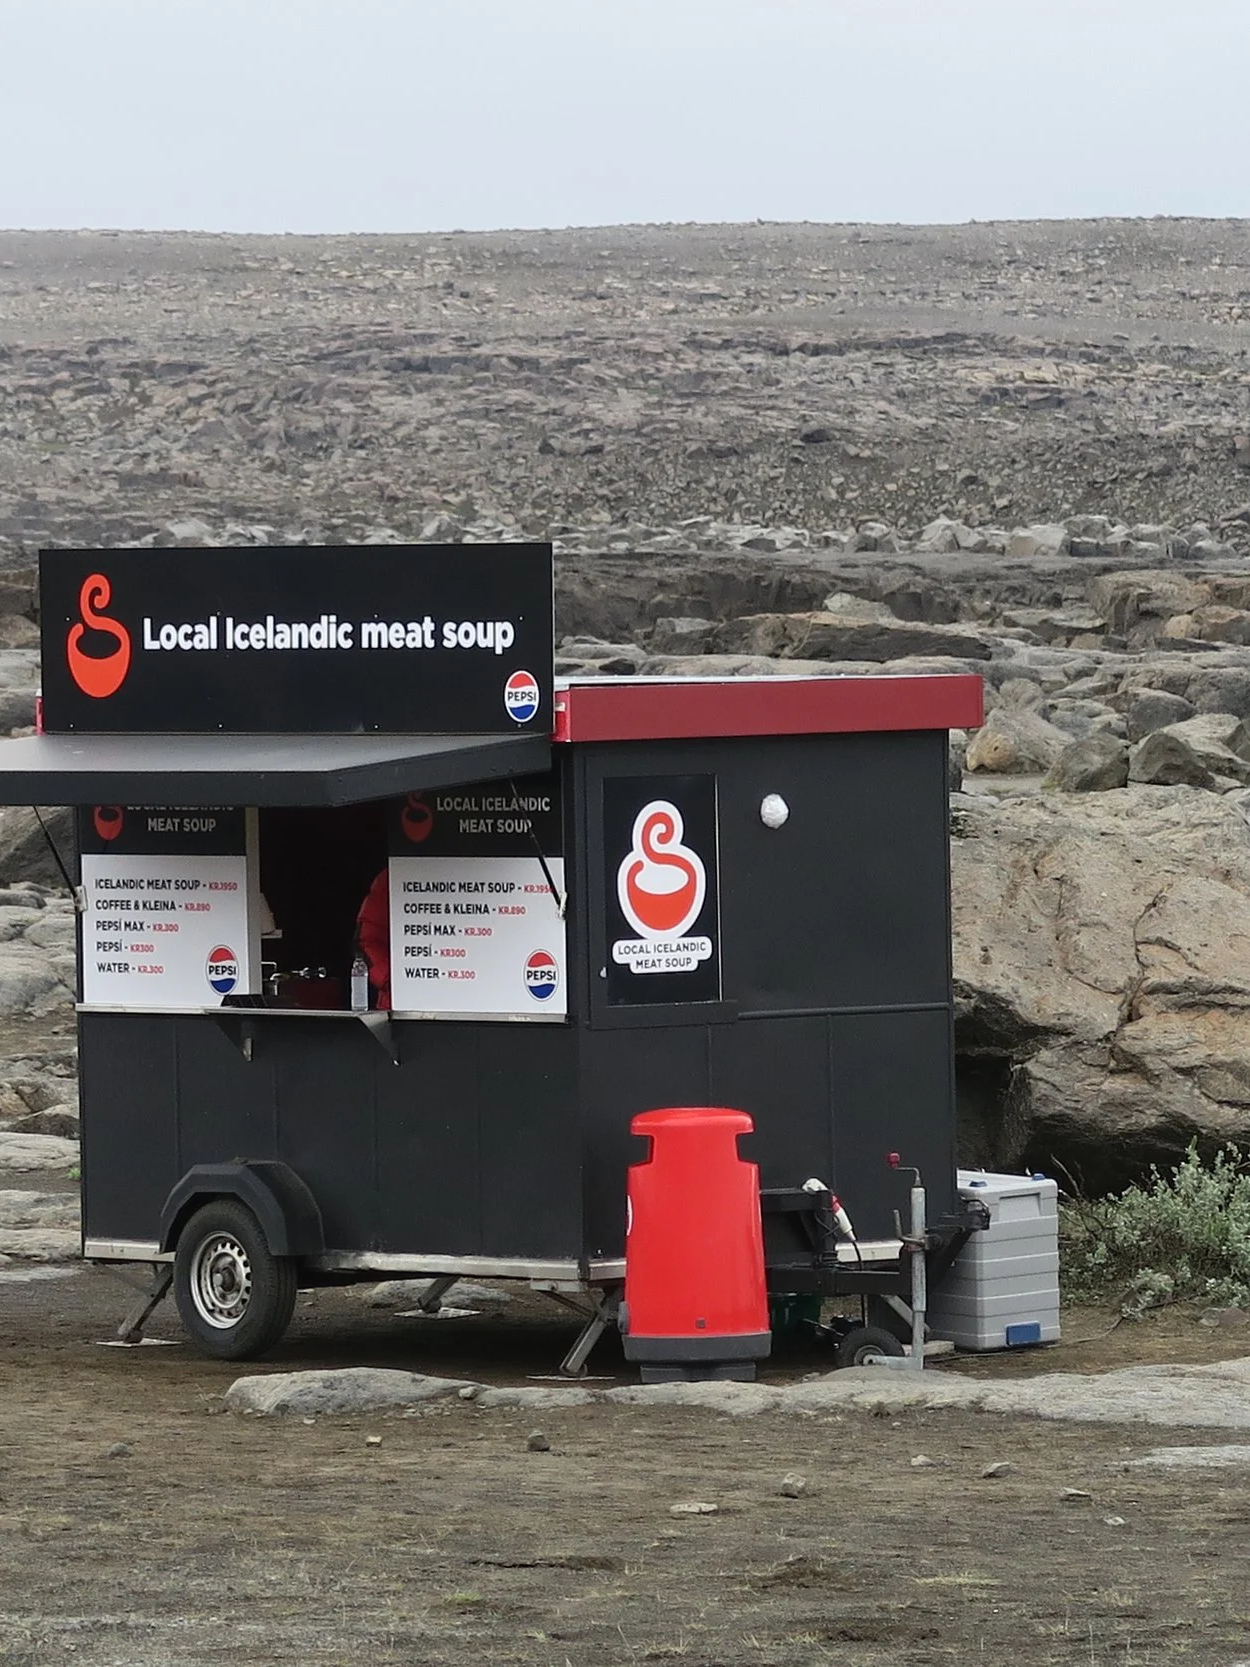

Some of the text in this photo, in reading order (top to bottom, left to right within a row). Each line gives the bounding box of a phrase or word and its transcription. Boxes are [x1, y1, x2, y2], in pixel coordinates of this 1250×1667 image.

[143, 615, 515, 654] Local Icelandic meat soup
[507, 691, 537, 702] PEPSI
[436, 797, 551, 811] LOCAL ICELANDIC
[147, 818, 217, 832] MEAT SOUP
[459, 819, 532, 833] MEAT SOUP
[95, 879, 145, 890] ICELANDIC
[147, 879, 172, 890] MEAT
[174, 880, 201, 890] SOUP
[403, 881, 456, 893] ICELANDIC
[458, 882, 485, 893] MEAT
[488, 883, 516, 893] SOUP
[524, 884, 555, 893] KR.195
[95, 900, 131, 911] COFFEE
[133, 901, 140, 911] &
[142, 900, 177, 911] KLEINA
[403, 903, 442, 914] COFFEE
[444, 904, 451, 914] &
[453, 904, 490, 914] KLEINA
[124, 921, 145, 931] MAX
[434, 925, 456, 935] MAX
[618, 942, 707, 955] LOCAL ICELANDIC
[97, 962, 130, 973] WATER
[636, 957, 692, 969] MEAT SOUP
[208, 965, 237, 975] PEPSI
[405, 967, 439, 978] WATER
[526, 971, 556, 981] PEPSI
